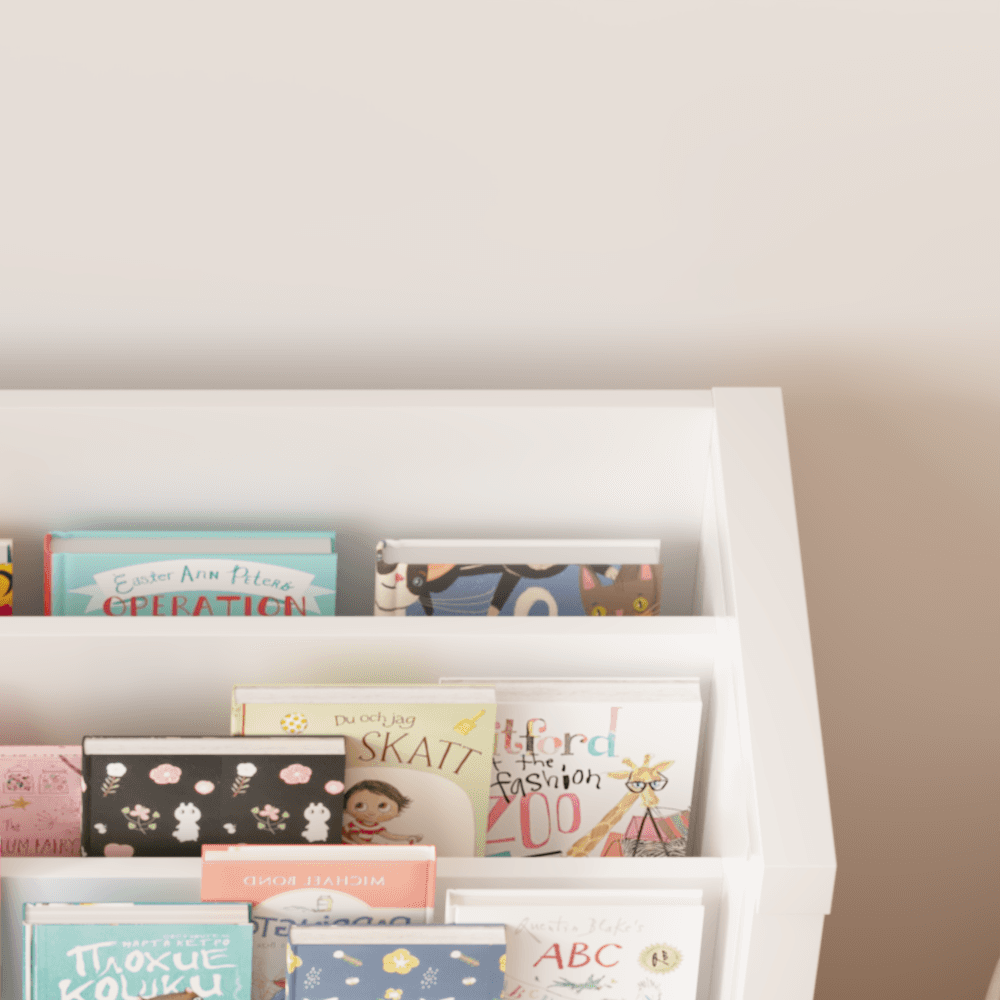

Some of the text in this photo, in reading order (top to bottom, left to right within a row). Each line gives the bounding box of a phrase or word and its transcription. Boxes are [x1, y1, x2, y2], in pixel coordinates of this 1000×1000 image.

[113, 571, 174, 594] Easter
[103, 596, 307, 616] OPERATION
[334, 712, 416, 729] Du och jag
[494, 707, 622, 757] itford
[358, 731, 482, 774] SKATT
[516, 754, 553, 770] the
[490, 765, 601, 804] fashion
[533, 942, 623, 970] ABC
